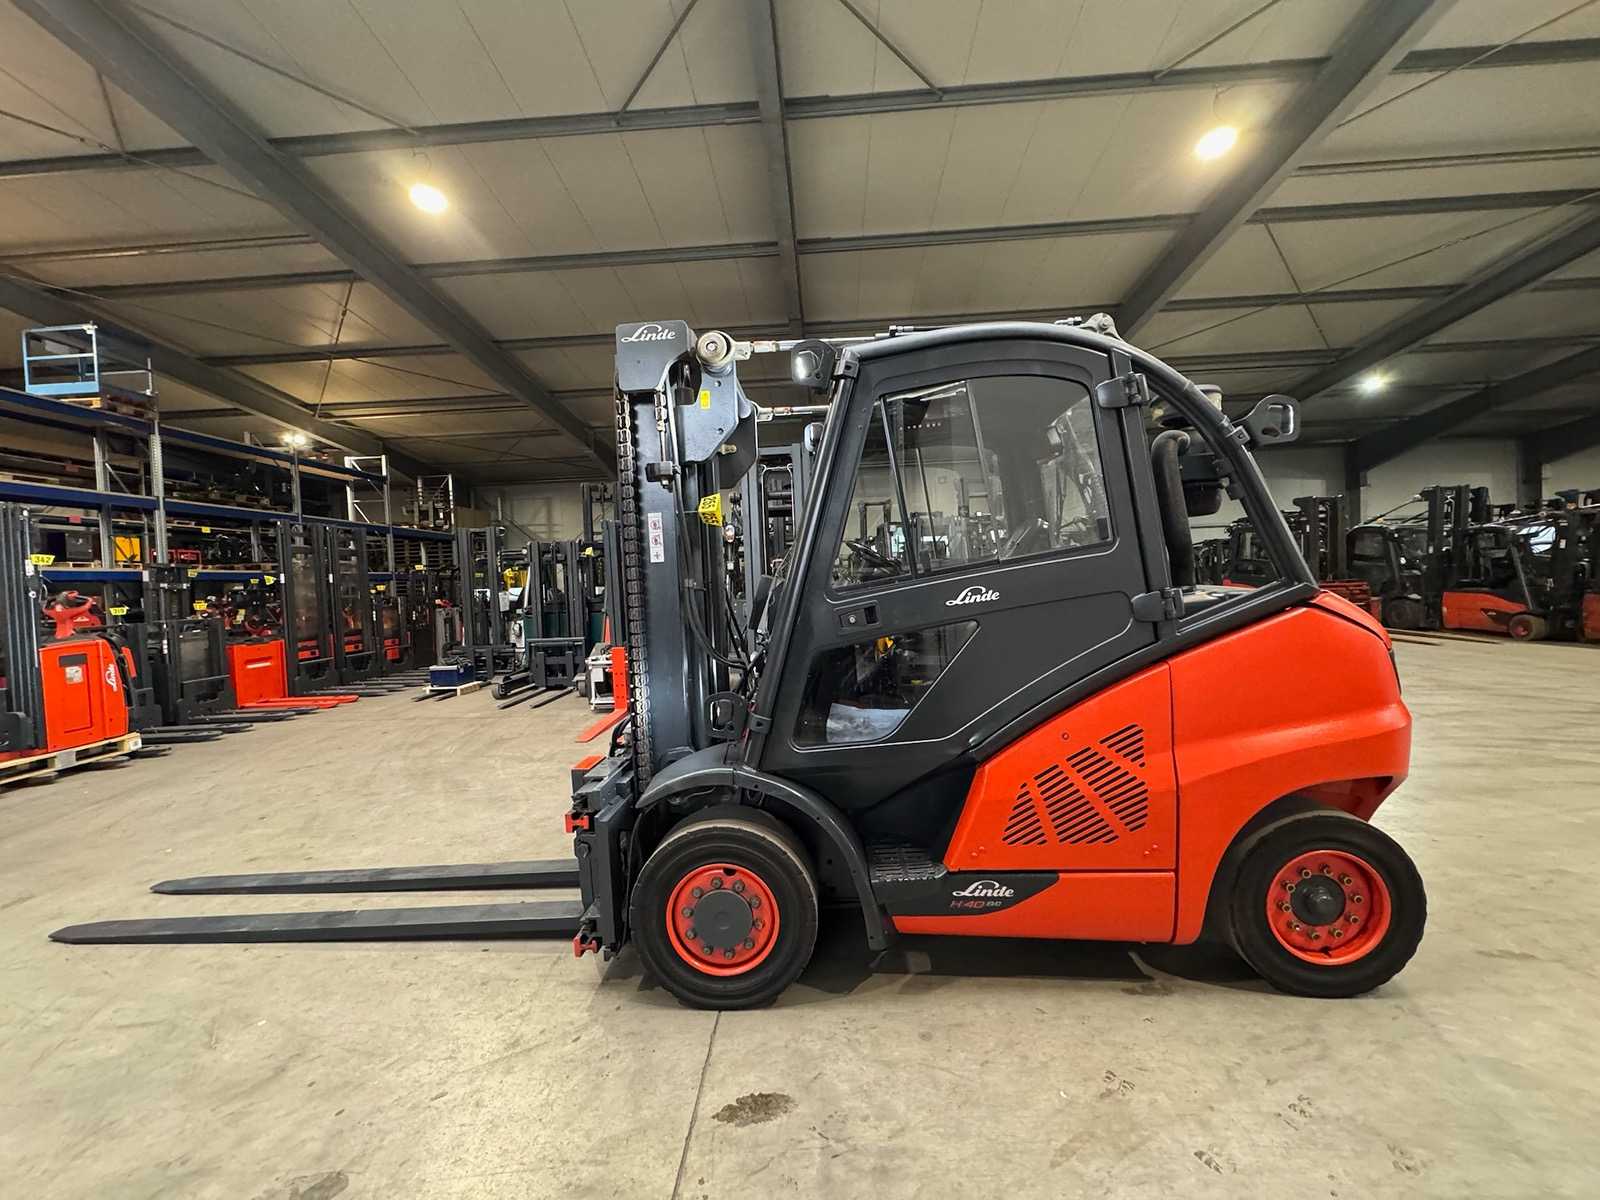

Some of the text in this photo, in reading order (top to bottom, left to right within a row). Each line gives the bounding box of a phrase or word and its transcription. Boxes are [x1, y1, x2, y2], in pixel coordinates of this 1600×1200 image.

[621, 324, 676, 343] Linde
[945, 585, 1000, 606] Linde
[952, 879, 1015, 898] Linde
